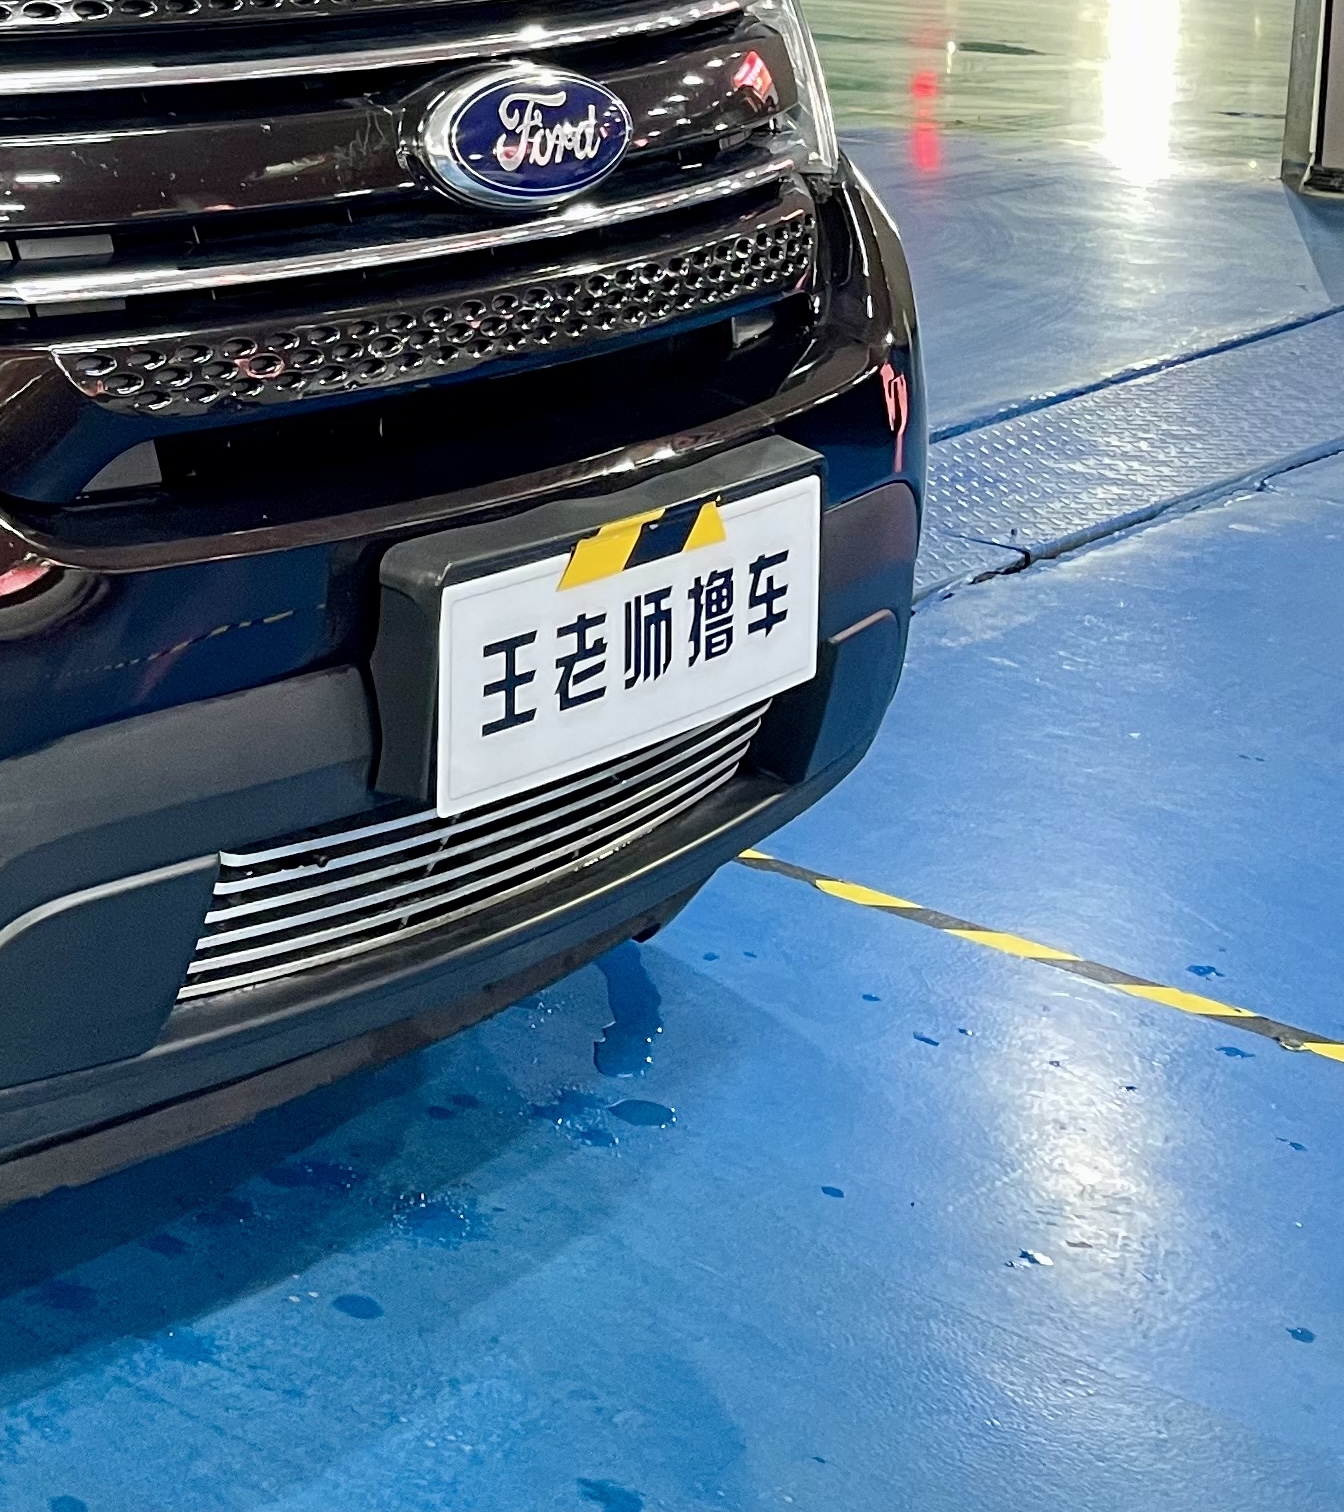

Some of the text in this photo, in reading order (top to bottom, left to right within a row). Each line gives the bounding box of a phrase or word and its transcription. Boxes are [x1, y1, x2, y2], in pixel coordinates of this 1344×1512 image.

[494, 90, 601, 172] Ford
[481, 549, 790, 738] 王老师撸车
